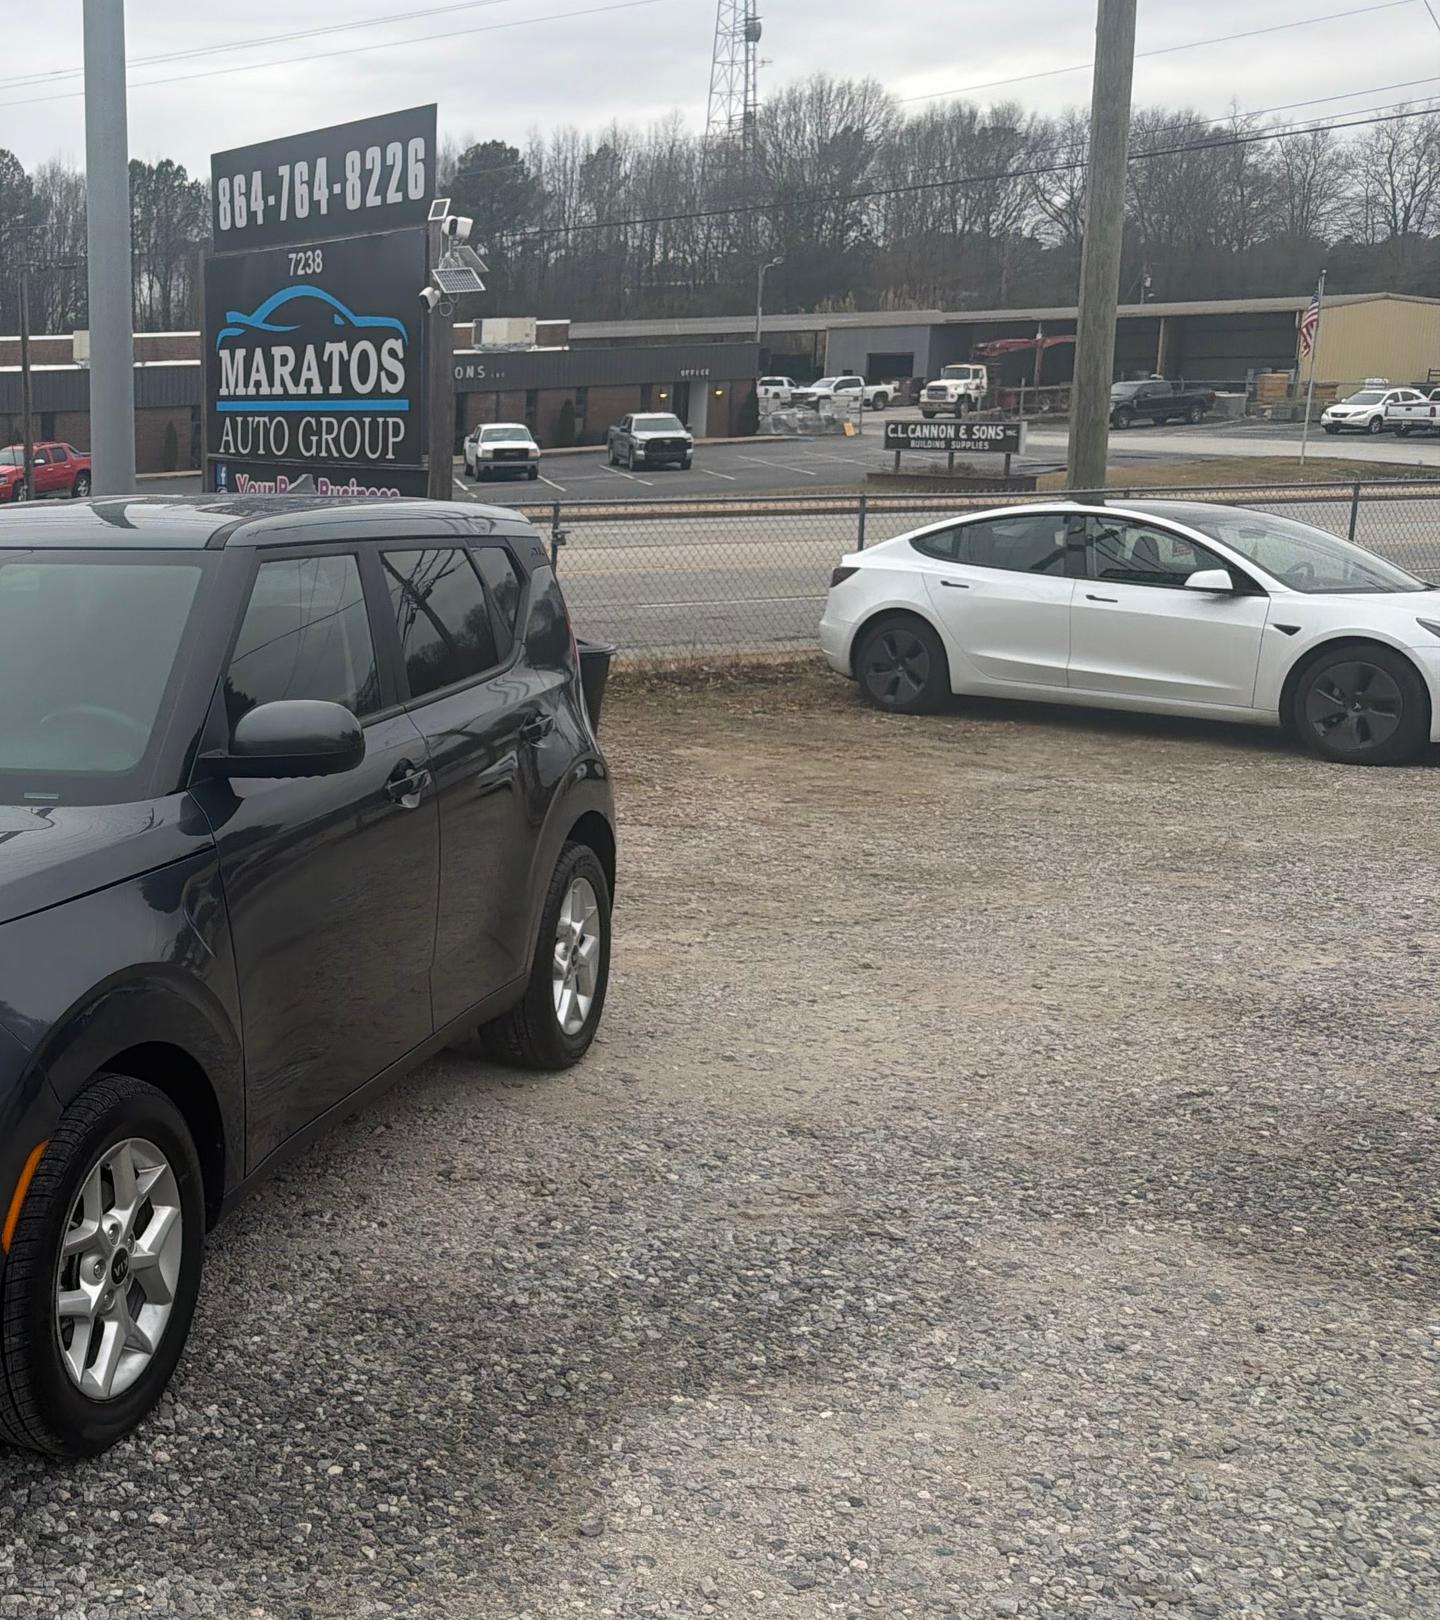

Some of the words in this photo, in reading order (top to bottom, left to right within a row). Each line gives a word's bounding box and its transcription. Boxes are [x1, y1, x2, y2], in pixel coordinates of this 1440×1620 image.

[217, 136, 426, 231] 864-764-8226
[288, 249, 323, 276] 7238
[219, 338, 406, 396] MARATOS
[219, 416, 289, 455] AUTO
[298, 416, 405, 460] GROUP
[907, 424, 956, 439] CANNON
[958, 425, 967, 439] &
[971, 425, 1005, 440] SONS
[910, 439, 947, 449] BUILDING
[950, 440, 990, 450] SUPPLIES
